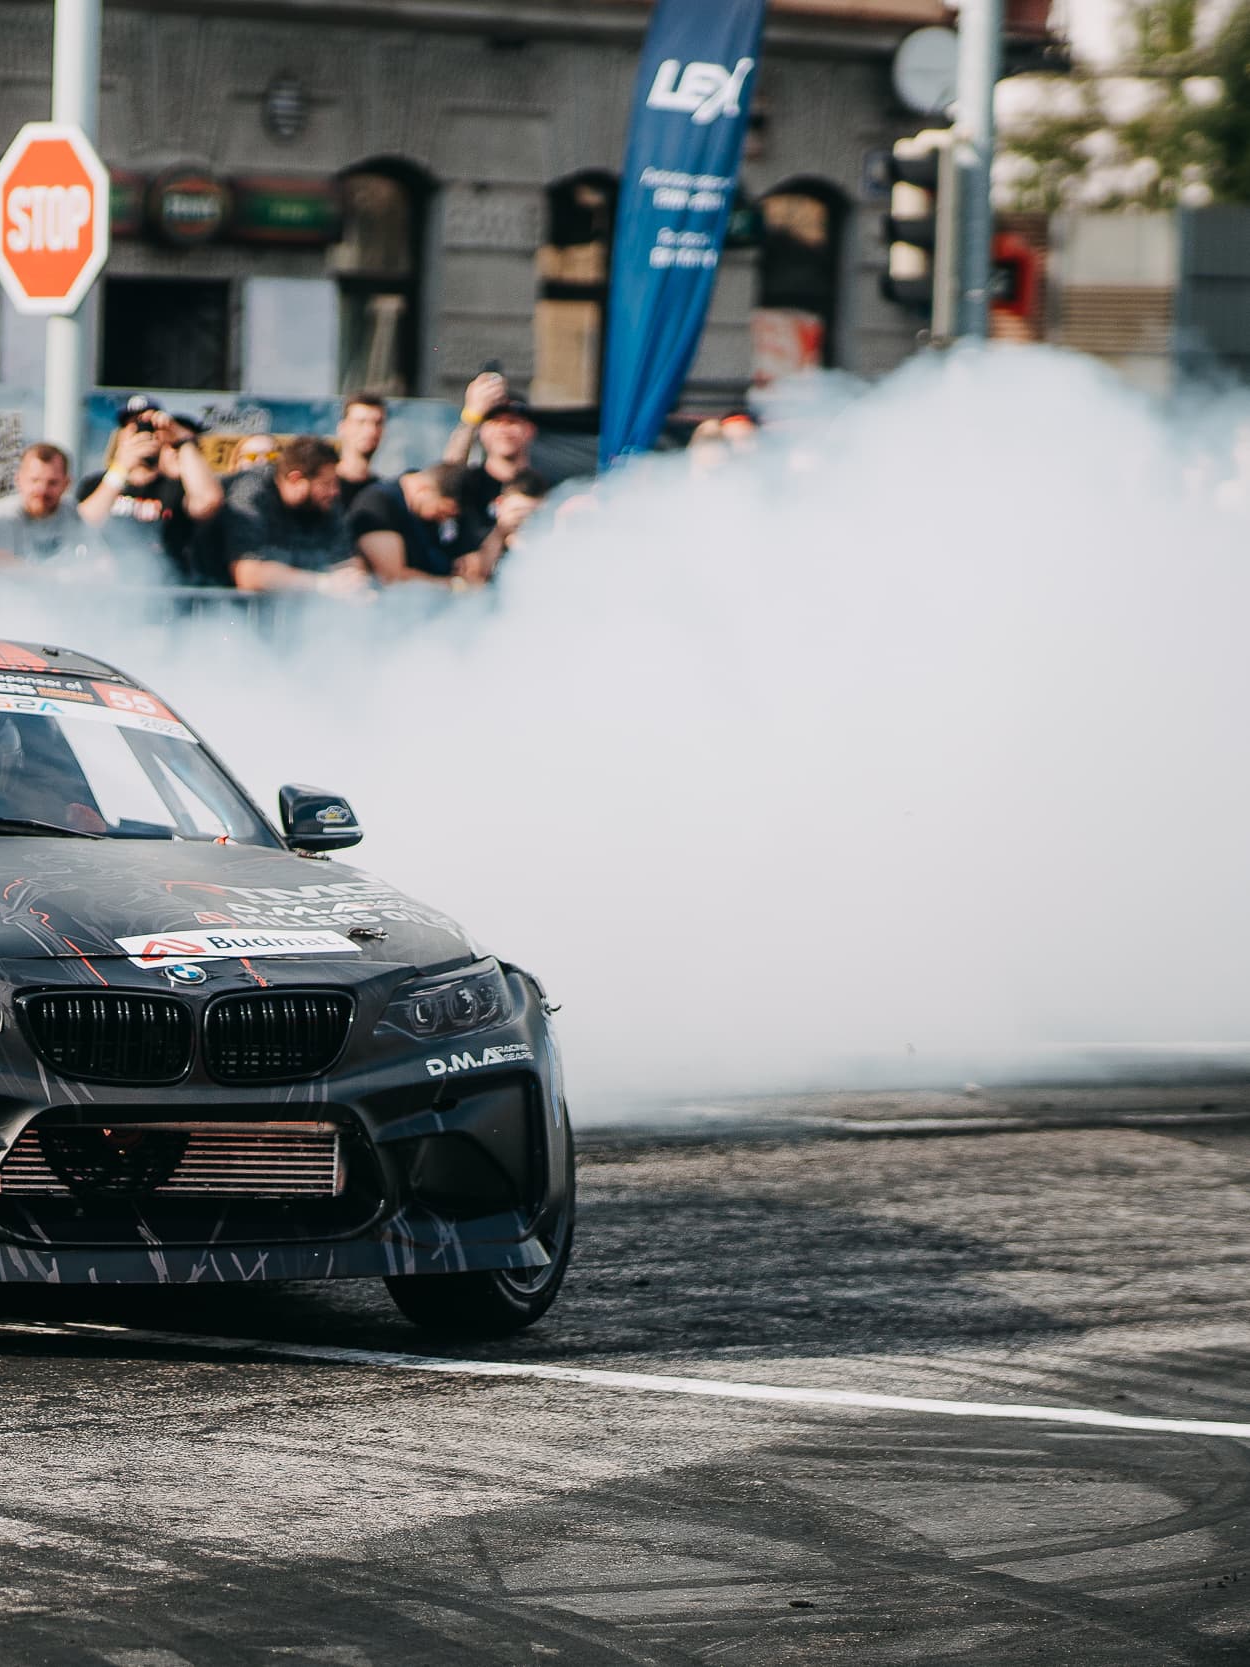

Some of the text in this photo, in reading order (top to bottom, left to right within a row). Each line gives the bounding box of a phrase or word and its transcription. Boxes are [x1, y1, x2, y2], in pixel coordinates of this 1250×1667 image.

[646, 57, 755, 125] LEX
[7, 185, 91, 252] STOP
[108, 690, 157, 715] 55
[230, 910, 381, 928] MILLERS
